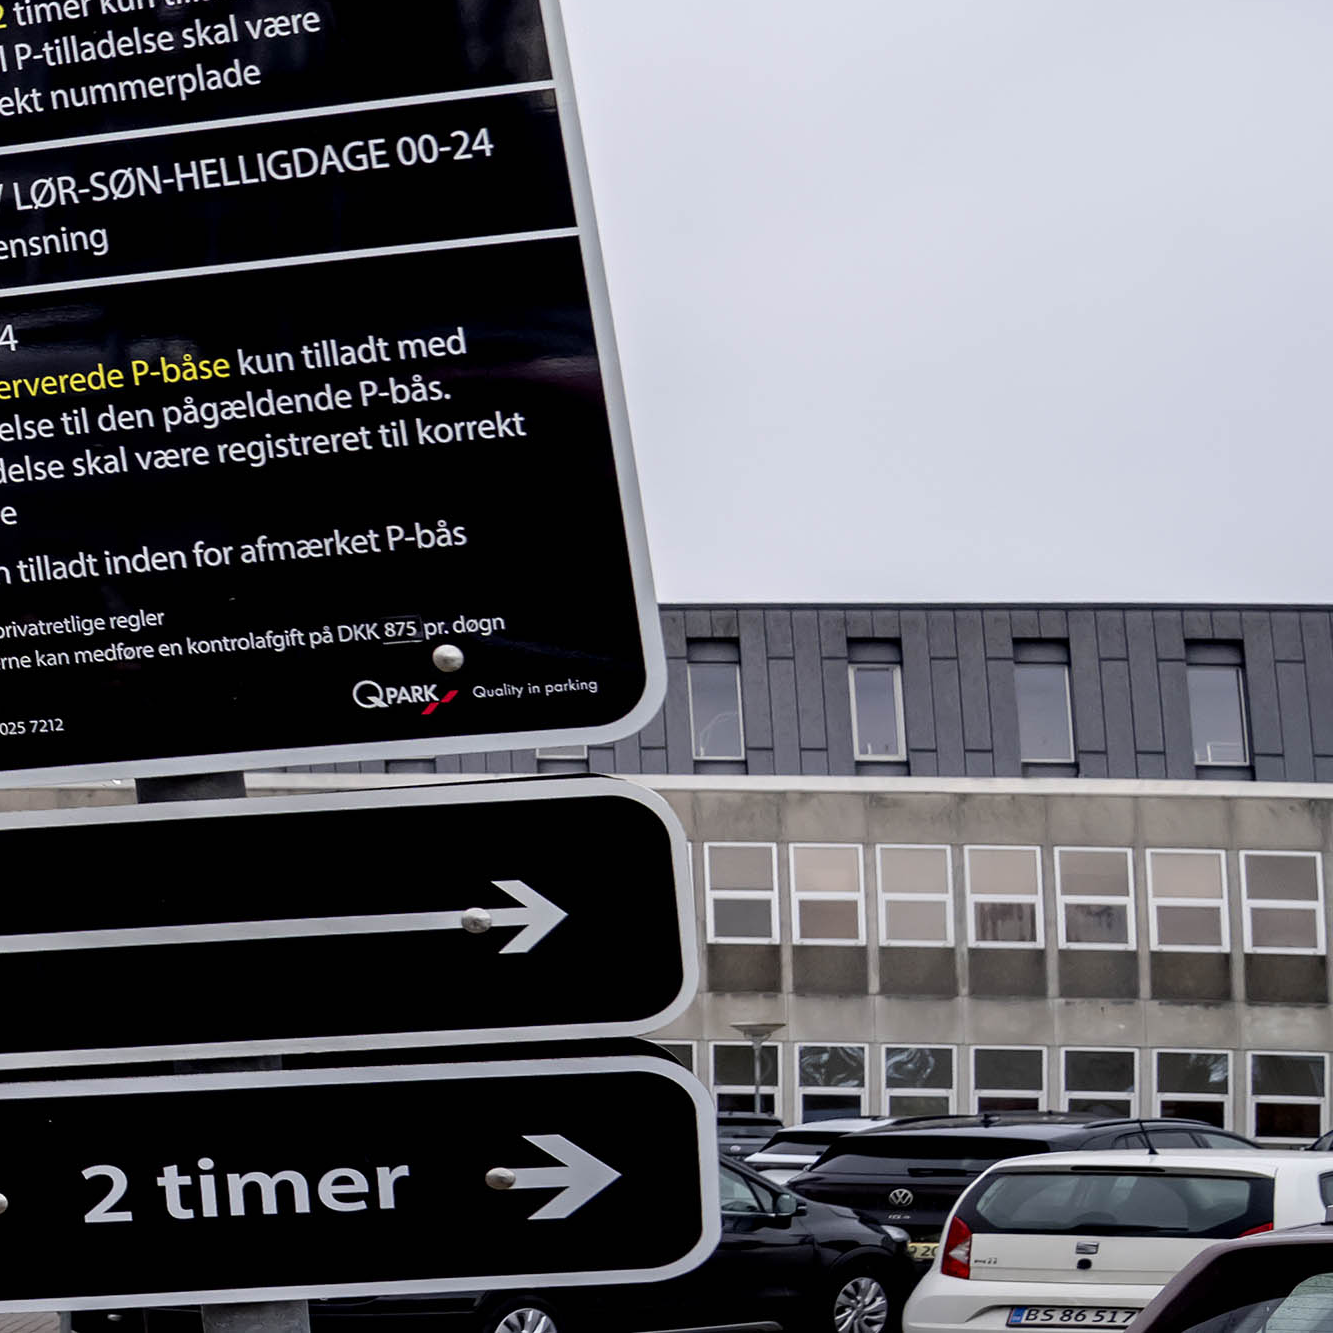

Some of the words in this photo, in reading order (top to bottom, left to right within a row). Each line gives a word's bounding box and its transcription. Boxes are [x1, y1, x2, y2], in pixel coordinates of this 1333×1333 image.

[14, 26, 175, 71] P-tilladelse
[182, 14, 239, 49] skal
[244, 11, 321, 40] være
[50, 58, 262, 110] nummerplade
[12, 138, 391, 211] LØR-SØN-HELLIGDAGE
[396, 127, 495, 166] 00-24
[131, 353, 231, 386] P-båse
[237, 348, 295, 376] kun
[300, 335, 392, 370] tilladt
[397, 326, 467, 360] med
[60, 407, 90, 436] til
[97, 404, 155, 432] den
[162, 383, 353, 433] pågældende
[359, 374, 452, 407] P-bås.
[72, 445, 129, 477] skal
[134, 446, 210, 471] være
[217, 426, 374, 468] registreret
[377, 419, 409, 448] til
[415, 410, 528, 445] korrekt
[16, 551, 100, 583] tilladt
[104, 545, 188, 576] inden
[192, 540, 234, 568] for
[240, 529, 382, 564] afmærket
[386, 519, 468, 551] P-bås
[35, 649, 71, 667] kan
[74, 642, 155, 664] medføre
[158, 642, 183, 657] en
[186, 629, 306, 655] kontrolafgift
[308, 626, 334, 650] på
[337, 623, 381, 643] DKK
[384, 620, 417, 639] 875
[423, 621, 449, 640] pr.
[452, 616, 506, 637] døgn
[109, 609, 165, 633] regler
[472, 683, 524, 699] Quality
[527, 683, 541, 694] in
[545, 678, 598, 696] parking
[29, 718, 65, 733] 7212
[81, 1164, 134, 1224] 2
[156, 1157, 410, 1220] timer
[1024, 1308, 1057, 1322] BS
[1059, 1308, 1088, 1323] 86
[1091, 1309, 1137, 1324] 517
